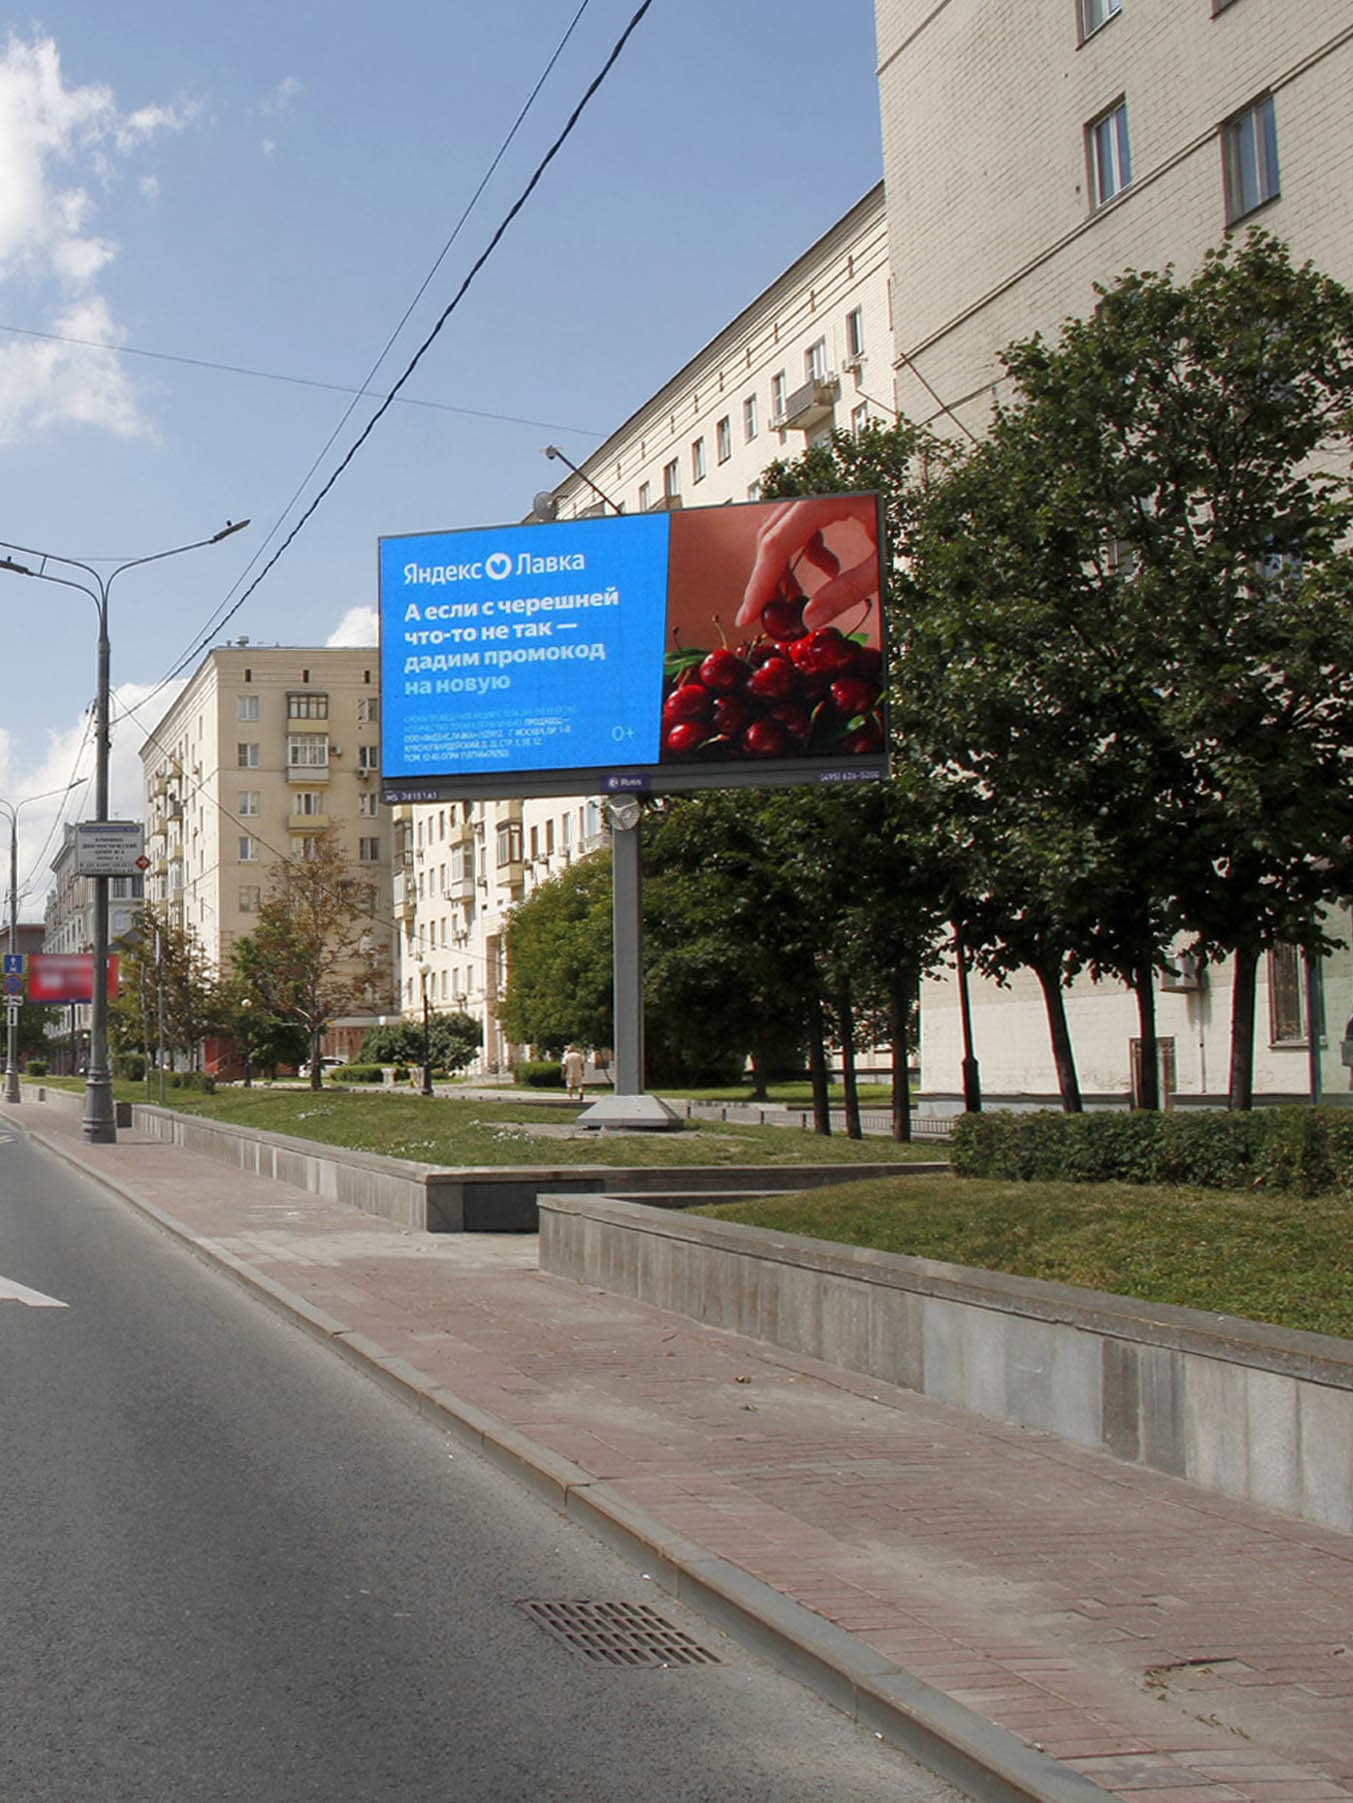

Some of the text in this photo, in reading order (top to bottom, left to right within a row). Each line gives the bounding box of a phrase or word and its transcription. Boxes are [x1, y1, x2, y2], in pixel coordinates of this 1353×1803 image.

[404, 553, 585, 585] Яндекс Лавка
[404, 586, 620, 622] А если с черешней
[404, 625, 477, 645] что-то
[481, 624, 509, 641] не
[512, 621, 553, 638] так
[404, 643, 607, 674] дадим промокод
[404, 675, 511, 695] на новую
[611, 725, 635, 742] 0+
